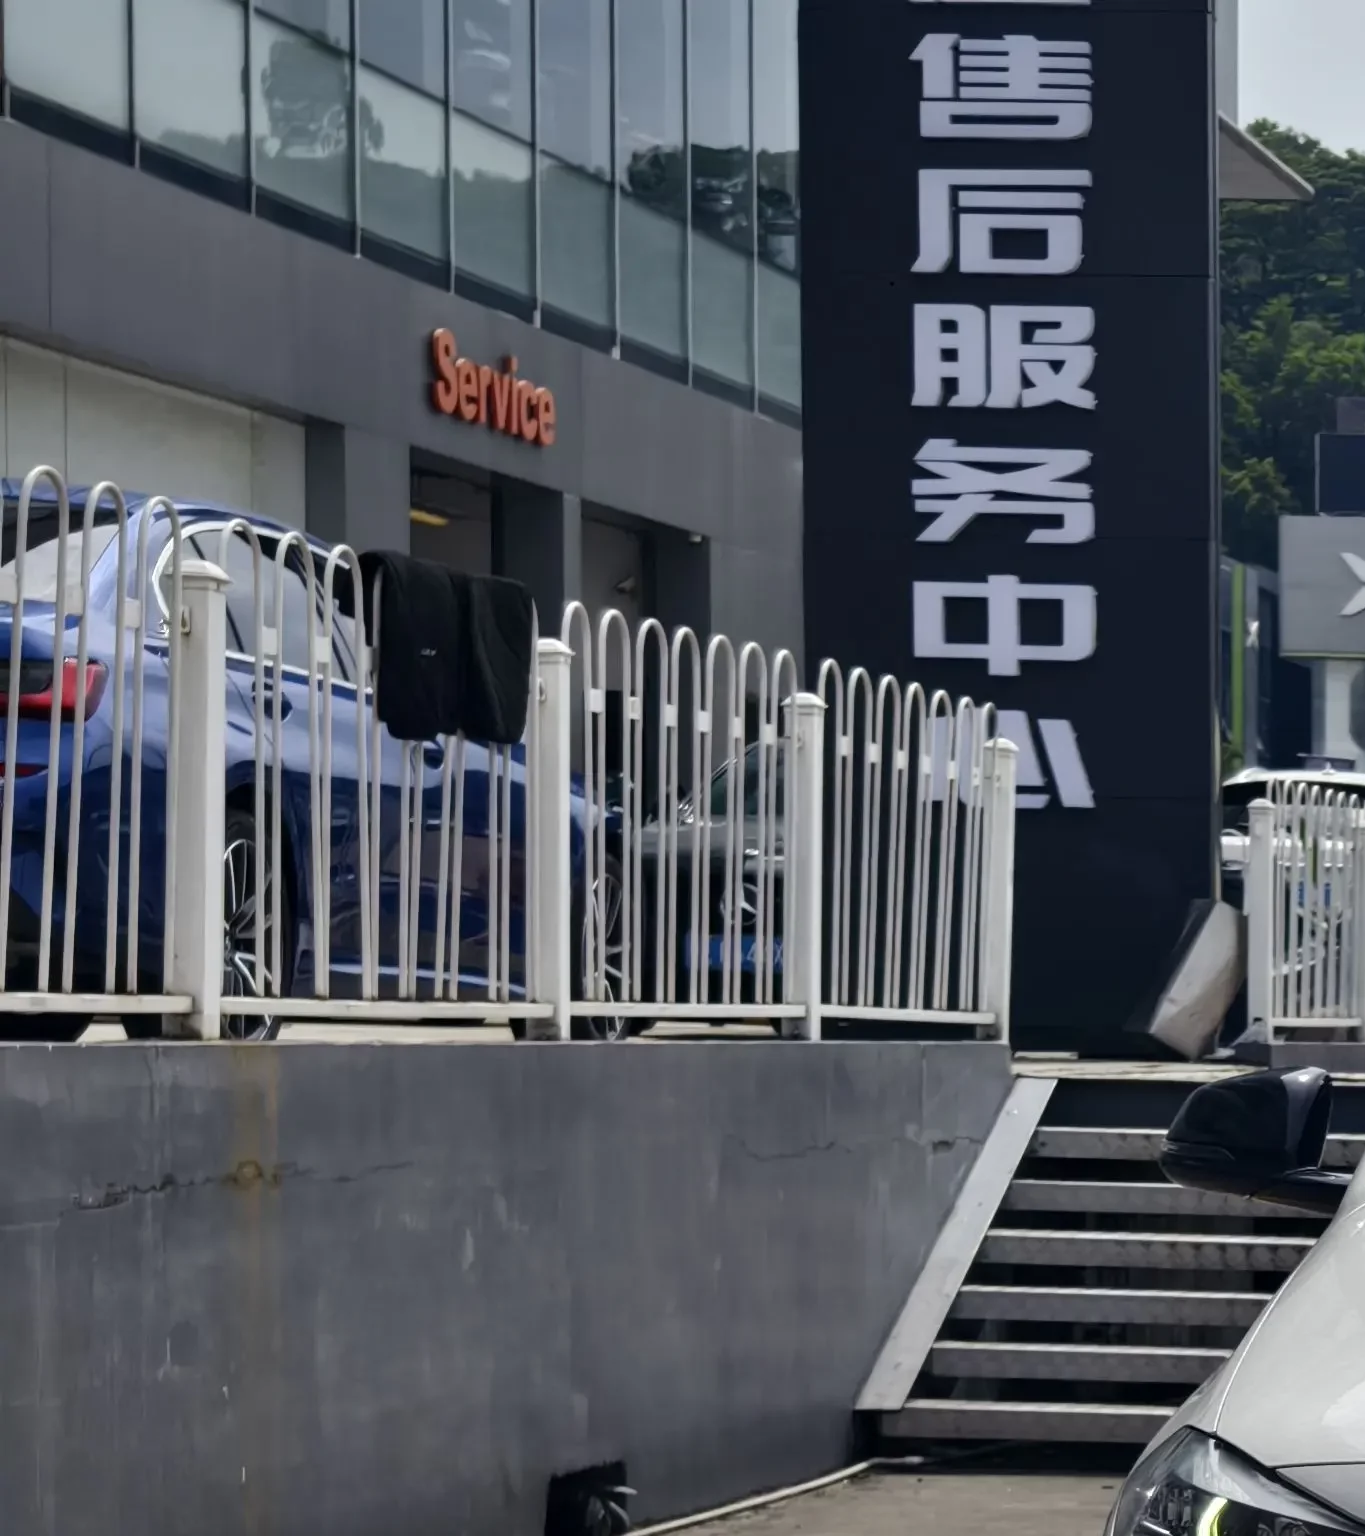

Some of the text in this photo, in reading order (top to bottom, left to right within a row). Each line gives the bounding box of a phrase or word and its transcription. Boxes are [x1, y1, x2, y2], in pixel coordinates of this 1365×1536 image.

[433, 327, 556, 445] Service
[909, 0, 1097, 808] 售后服务中心
